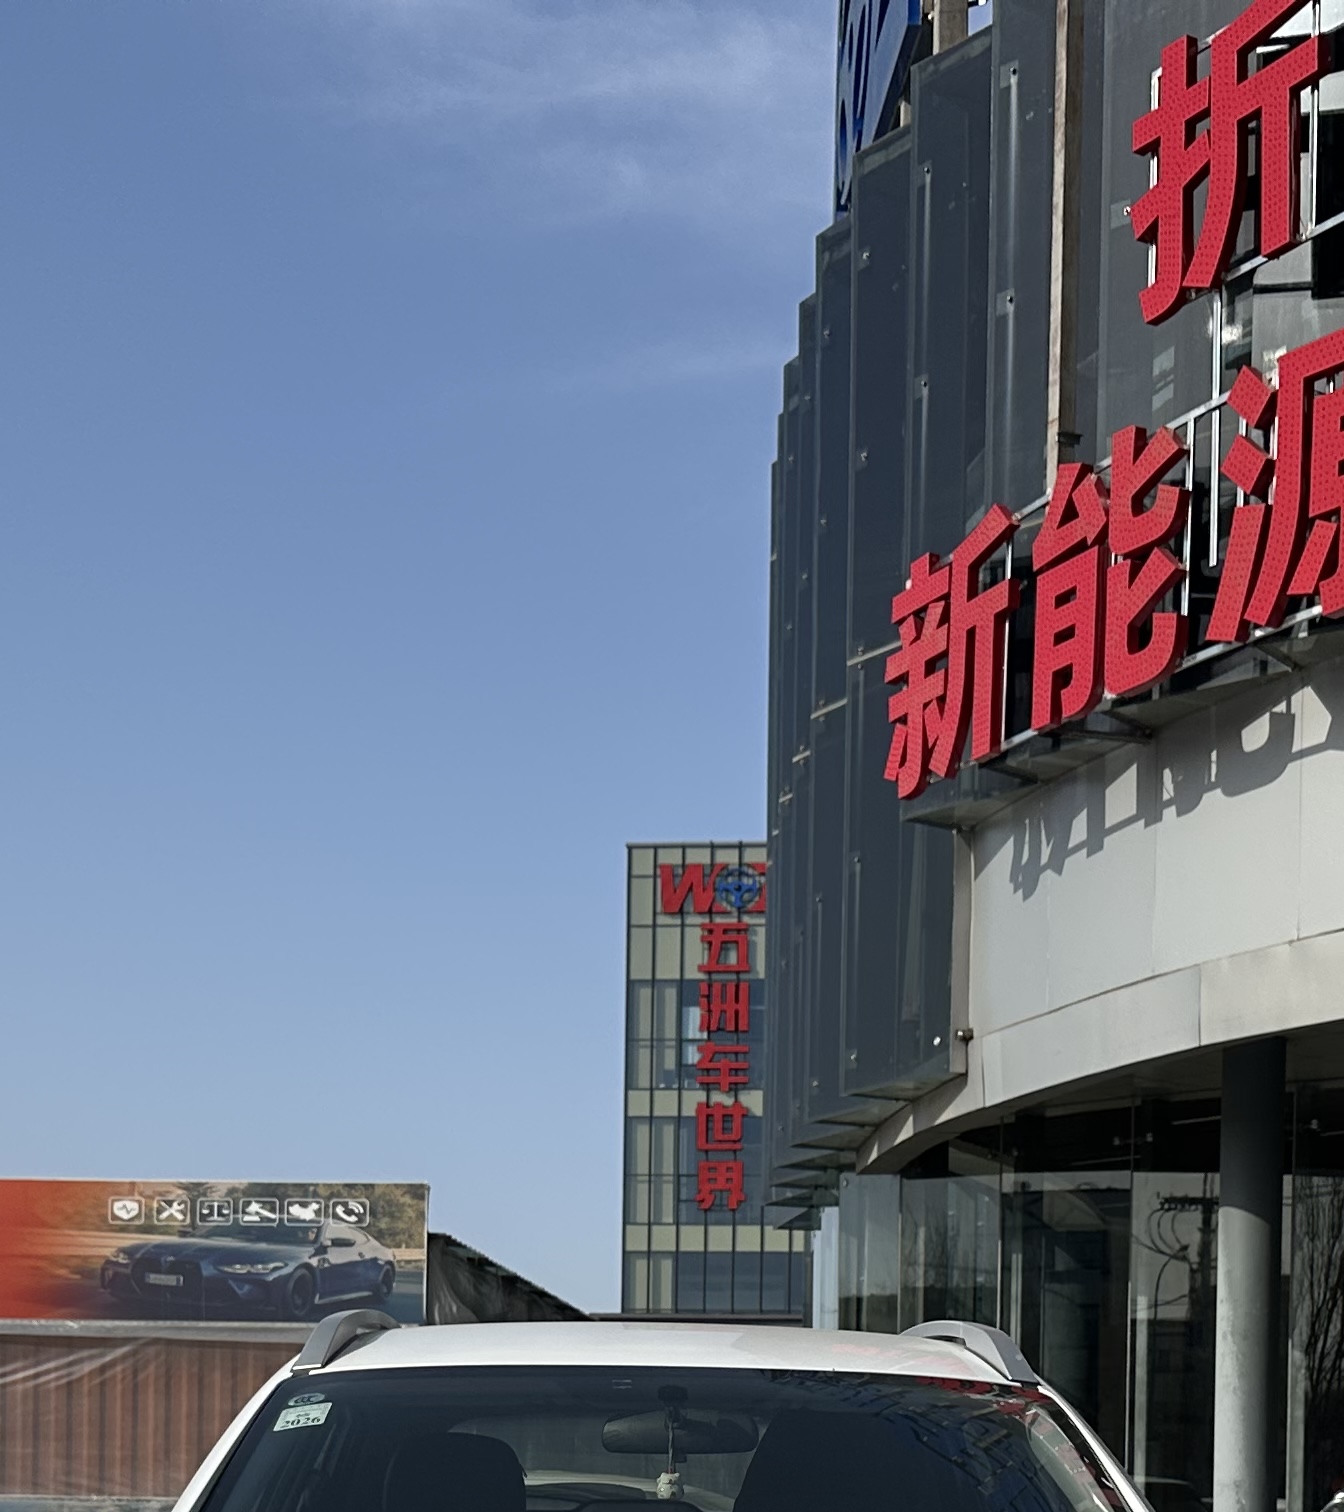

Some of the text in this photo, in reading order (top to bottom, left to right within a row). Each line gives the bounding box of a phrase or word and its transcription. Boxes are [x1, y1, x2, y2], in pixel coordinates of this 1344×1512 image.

[695, 922, 750, 1211] 五洲车世界
